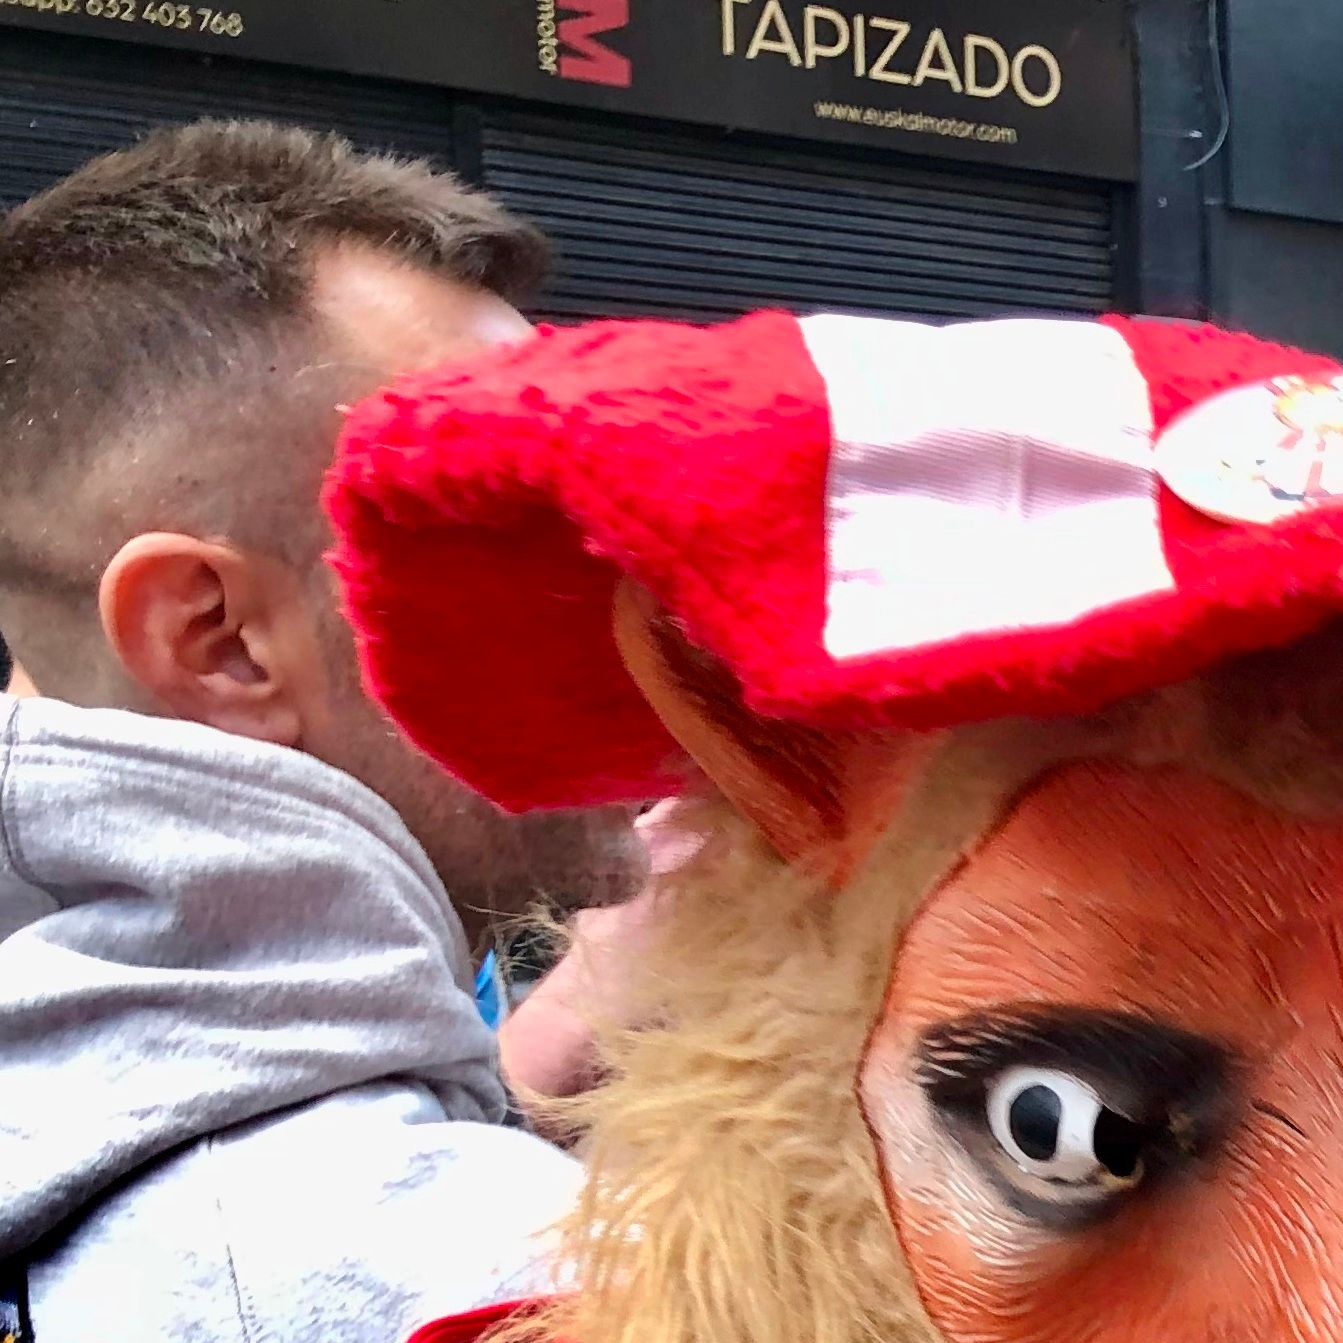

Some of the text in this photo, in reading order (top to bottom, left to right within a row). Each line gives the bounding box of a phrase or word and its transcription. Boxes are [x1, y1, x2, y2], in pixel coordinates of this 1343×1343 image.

[142, 2, 192, 29] 403
[196, 7, 243, 37] 768
[719, 0, 1063, 107] TAPIZADO
[813, 100, 1019, 145] www.euskalmotor.com
